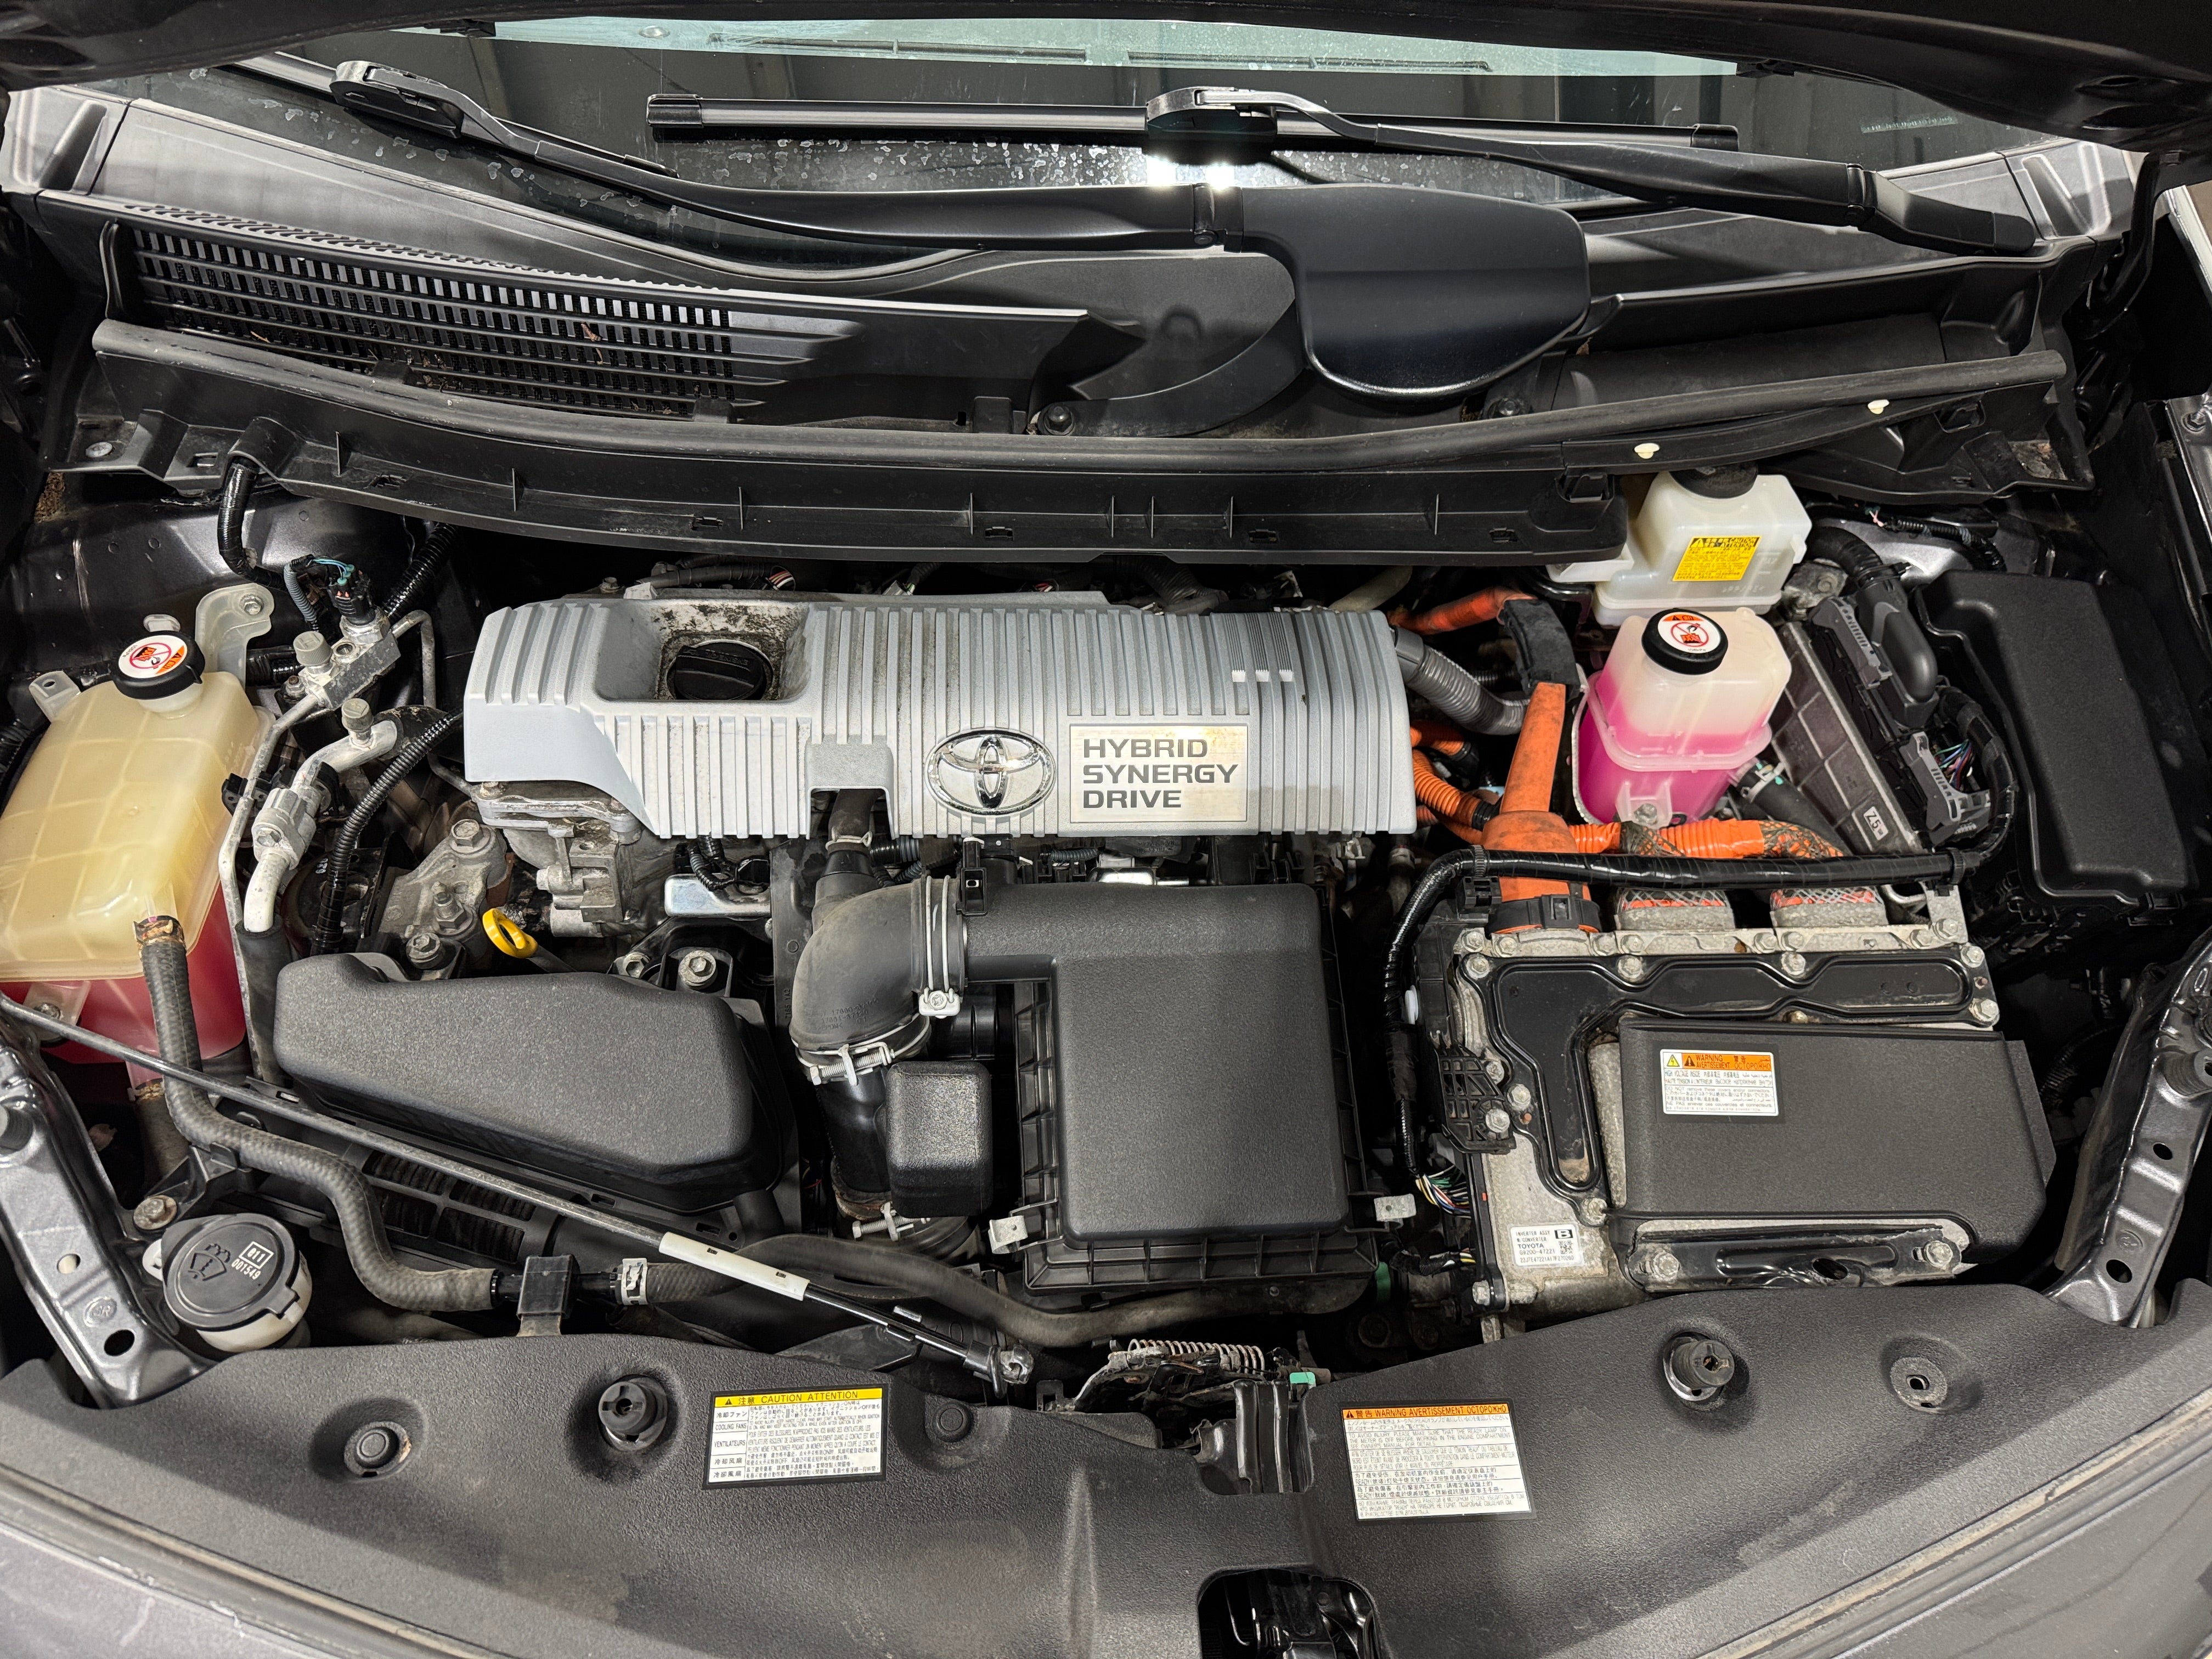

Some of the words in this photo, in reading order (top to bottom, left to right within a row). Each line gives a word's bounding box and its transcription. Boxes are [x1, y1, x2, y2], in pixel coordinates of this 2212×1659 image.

[1083, 738, 1208, 758] HYBRID
[1083, 764, 1238, 783] SYNERGY
[1083, 789, 1182, 808] DRIVE
[1556, 1229, 1571, 1238] B
[231, 1258, 261, 1280] 001549
[738, 1396, 755, 1405] 注意
[761, 1393, 802, 1403] CAUTION
[807, 1390, 857, 1401] ATTENTION
[1356, 1409, 1373, 1418] 警告
[1374, 1408, 1407, 1417] WARNING
[1408, 1406, 1465, 1416] AVERTISSEMENT
[1466, 1404, 1507, 1414] ОСТОРОЖНО
